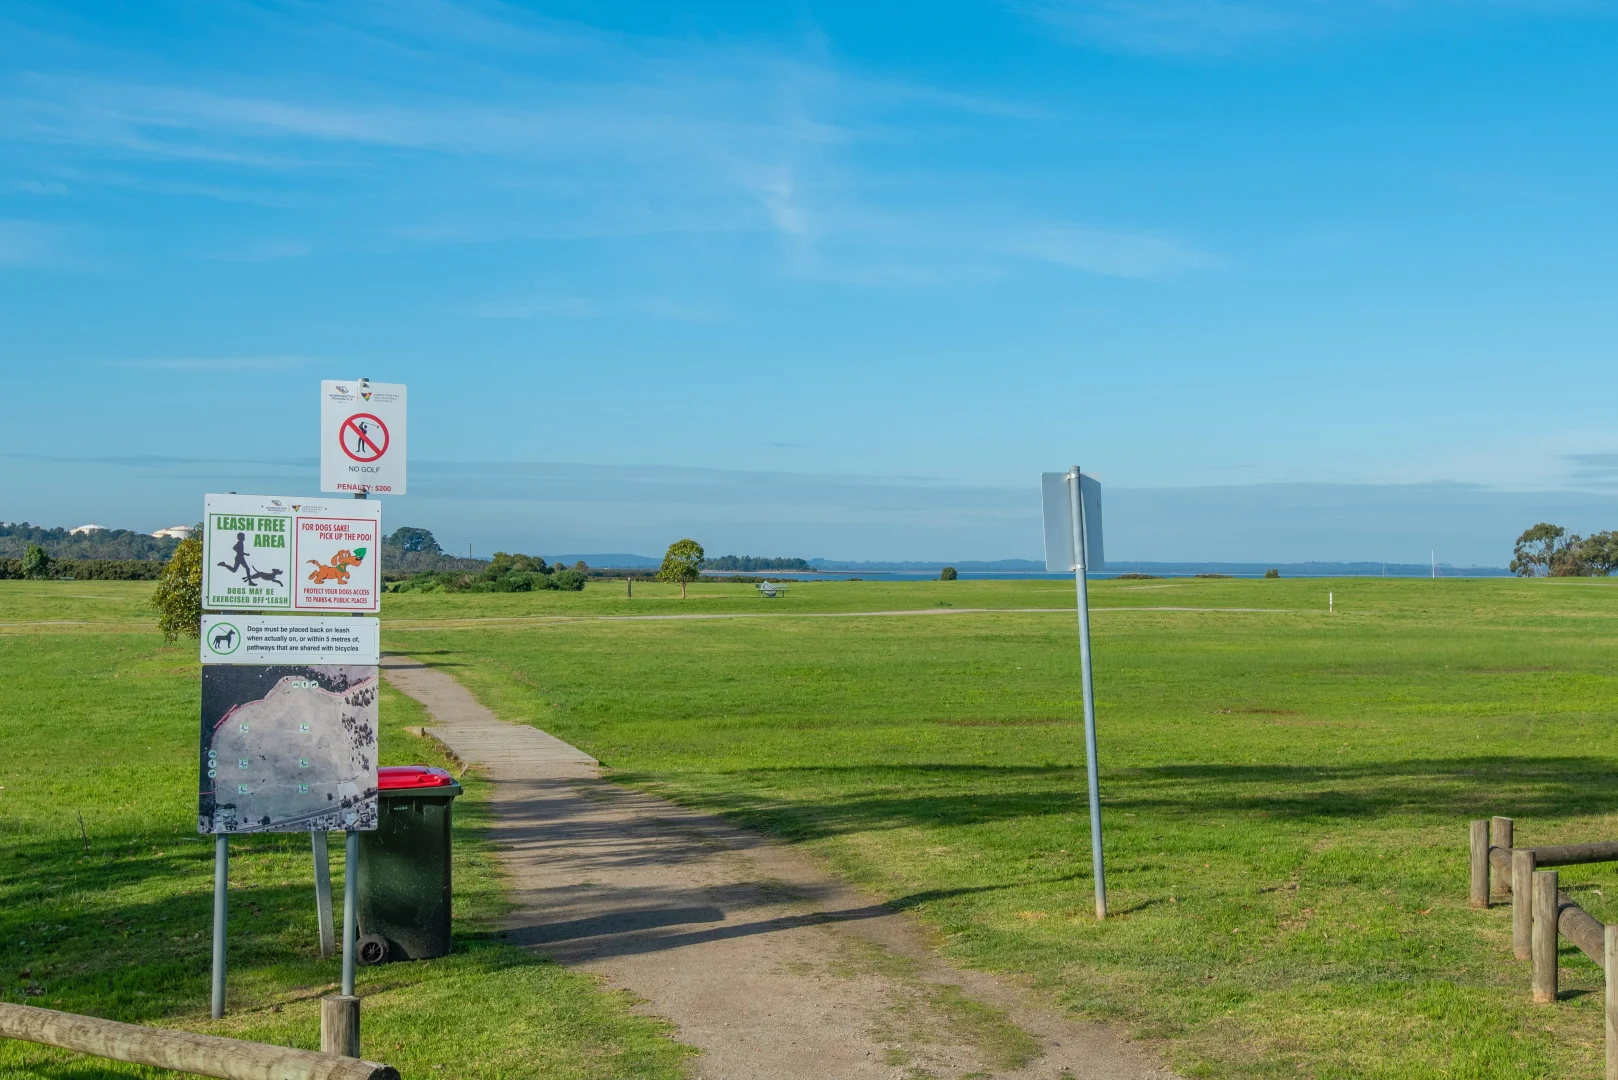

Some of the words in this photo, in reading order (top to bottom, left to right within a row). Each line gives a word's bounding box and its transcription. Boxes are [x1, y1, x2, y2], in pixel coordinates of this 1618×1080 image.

[217, 517, 254, 531] LEASH
[257, 518, 286, 532] FREE
[254, 534, 286, 548] AREA
[344, 533, 356, 541] THE
[334, 645, 359, 653] bicycles
